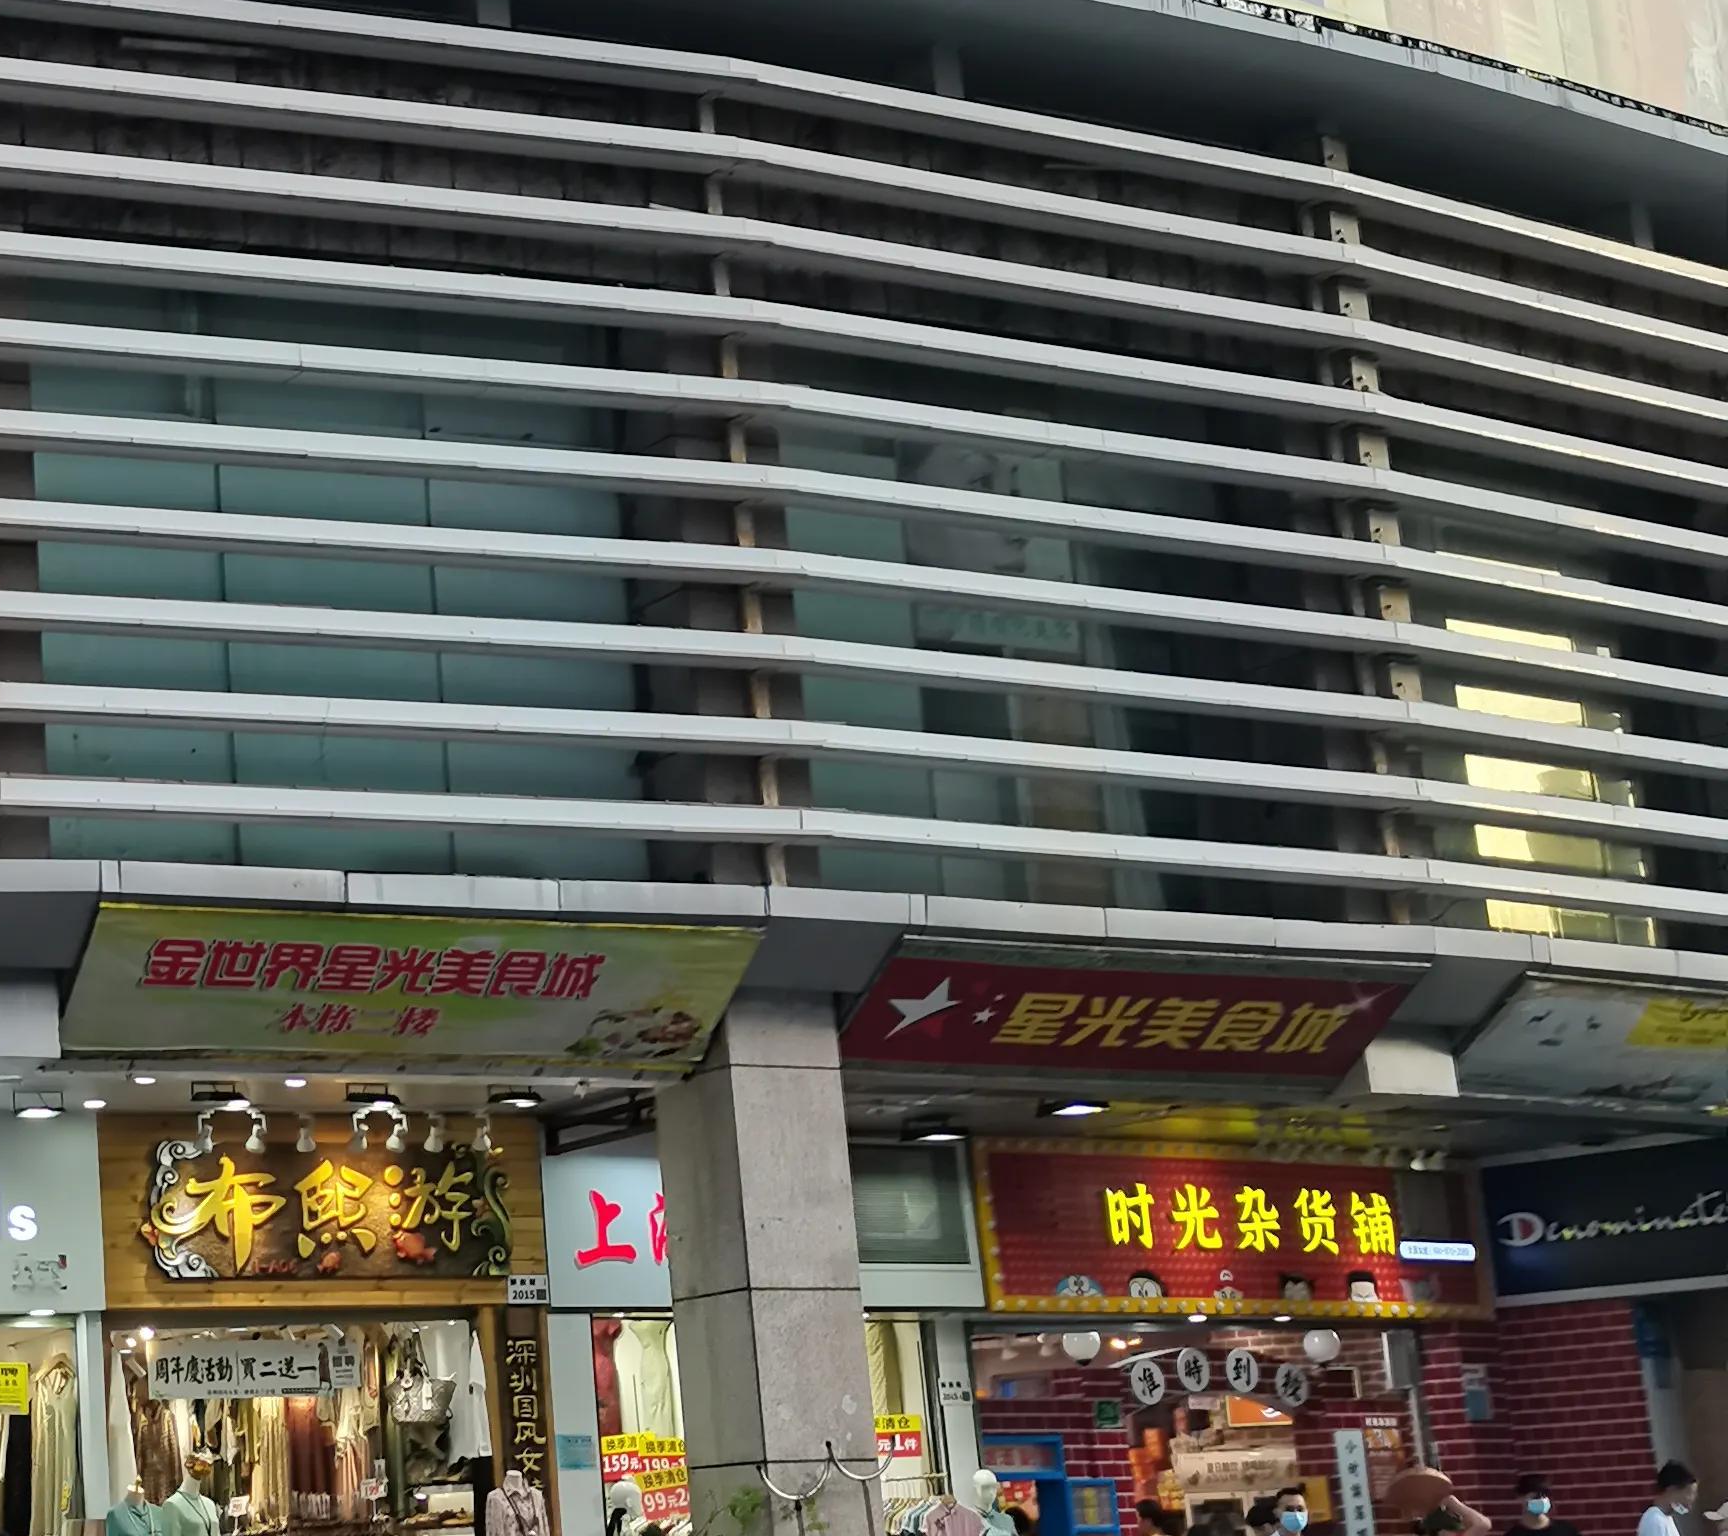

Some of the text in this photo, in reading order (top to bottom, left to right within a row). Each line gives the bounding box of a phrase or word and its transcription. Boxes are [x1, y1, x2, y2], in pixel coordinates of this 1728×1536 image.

[144, 939, 607, 1001] 金世界星光美食城
[275, 1004, 441, 1037] 本栋二楼
[990, 992, 1352, 1055] 星光美食城
[1105, 1182, 1396, 1256] 时光杂货铺
[512, 1290, 536, 1300] 2015
[506, 1338, 547, 1492] 深圳国风女
